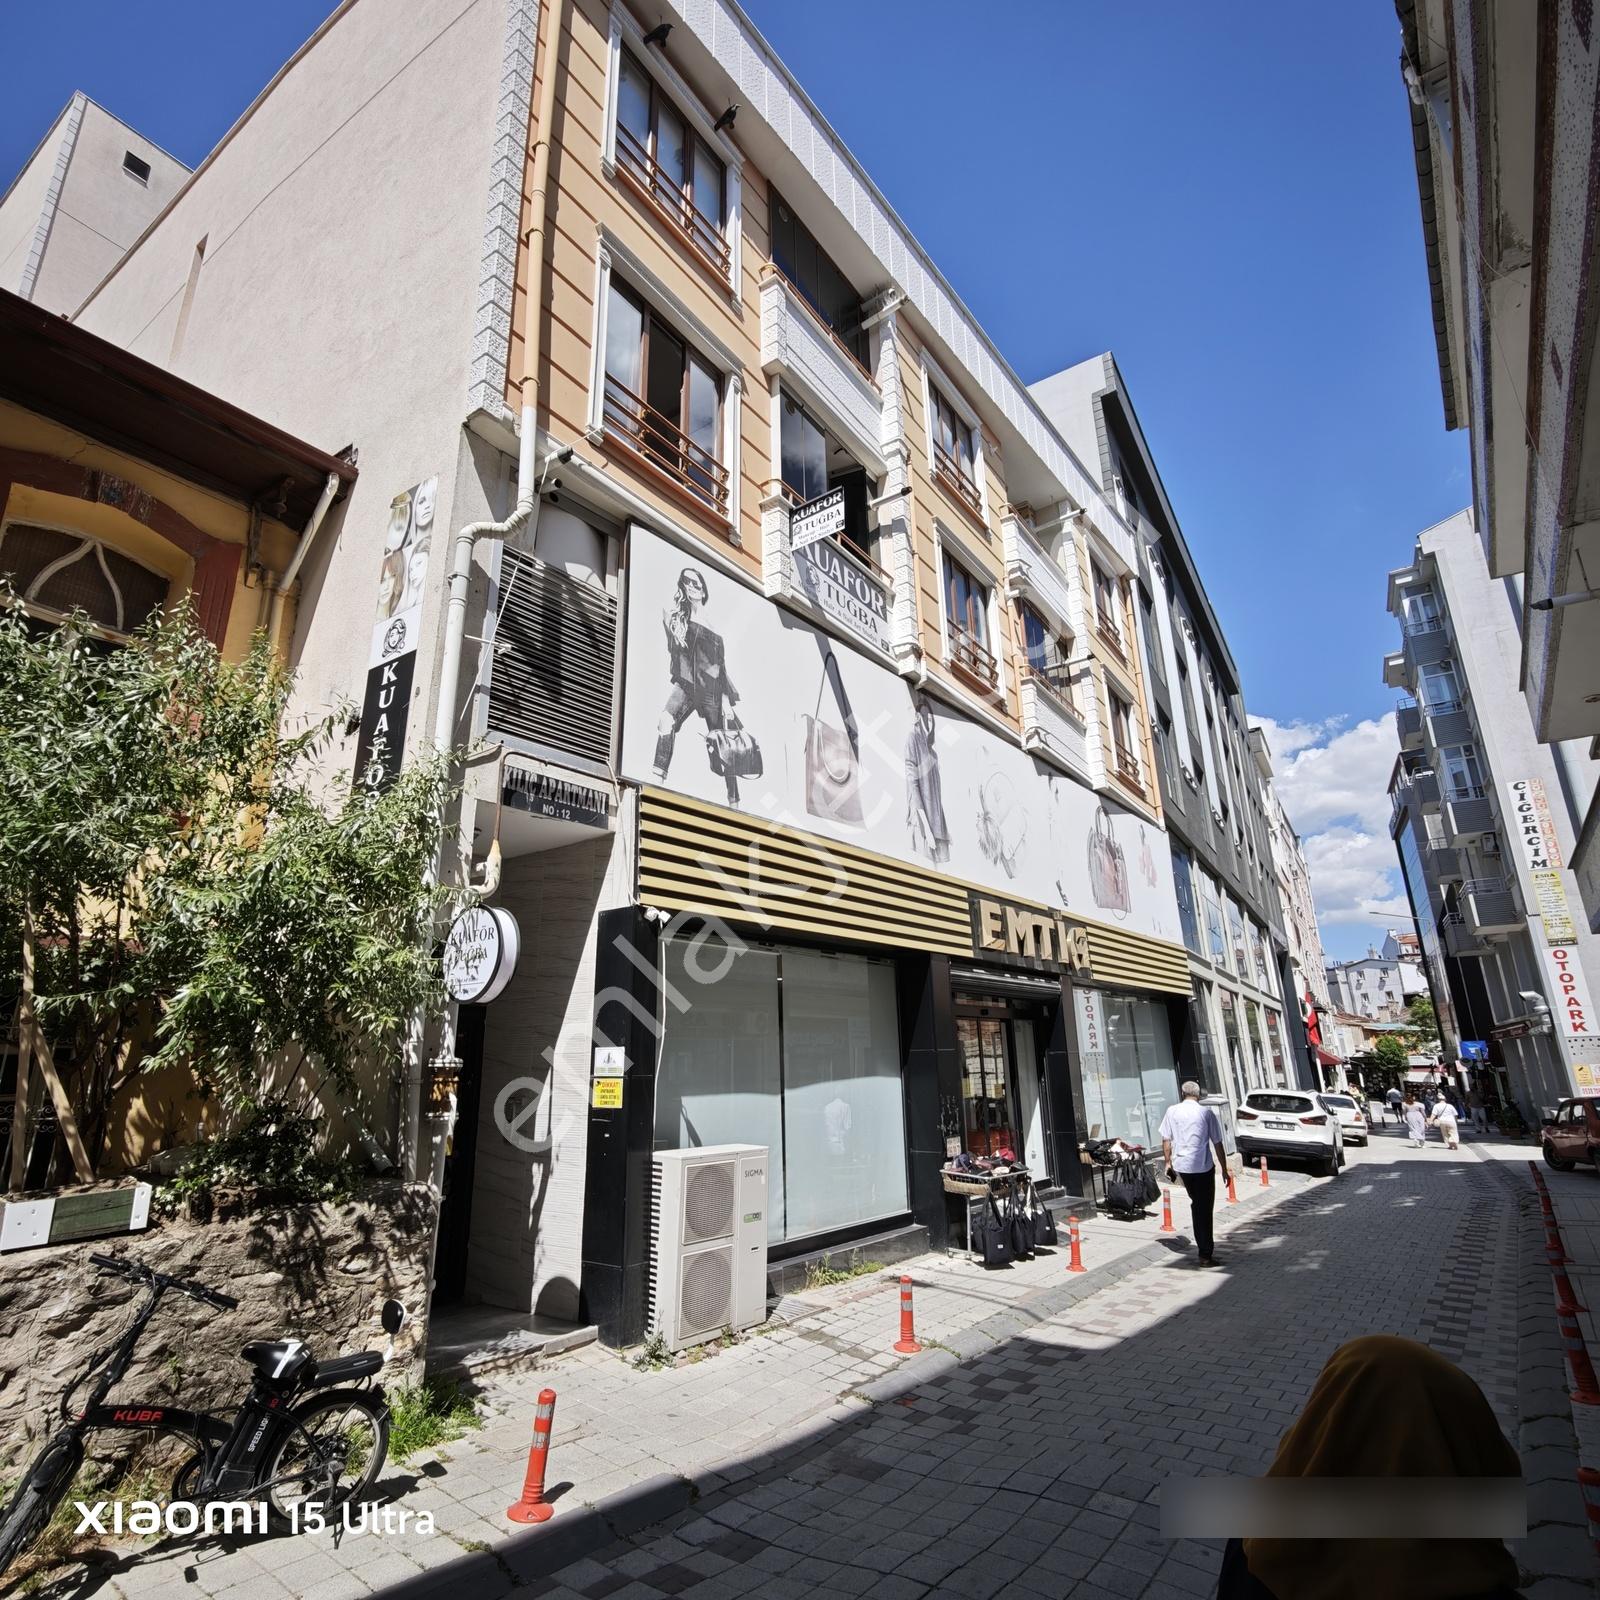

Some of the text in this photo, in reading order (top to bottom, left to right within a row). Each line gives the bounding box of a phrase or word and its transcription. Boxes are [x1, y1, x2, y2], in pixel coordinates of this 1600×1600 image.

[824, 581, 878, 633] TUĞBA
[539, 776, 606, 815] APARTMANI
[542, 804, 555, 816] NO
[561, 809, 571, 820] 12
[1552, 949, 1588, 1033] OTOPARK
[744, 1169, 763, 1178] SIGMA
[247, 1430, 263, 1452] SPEED
